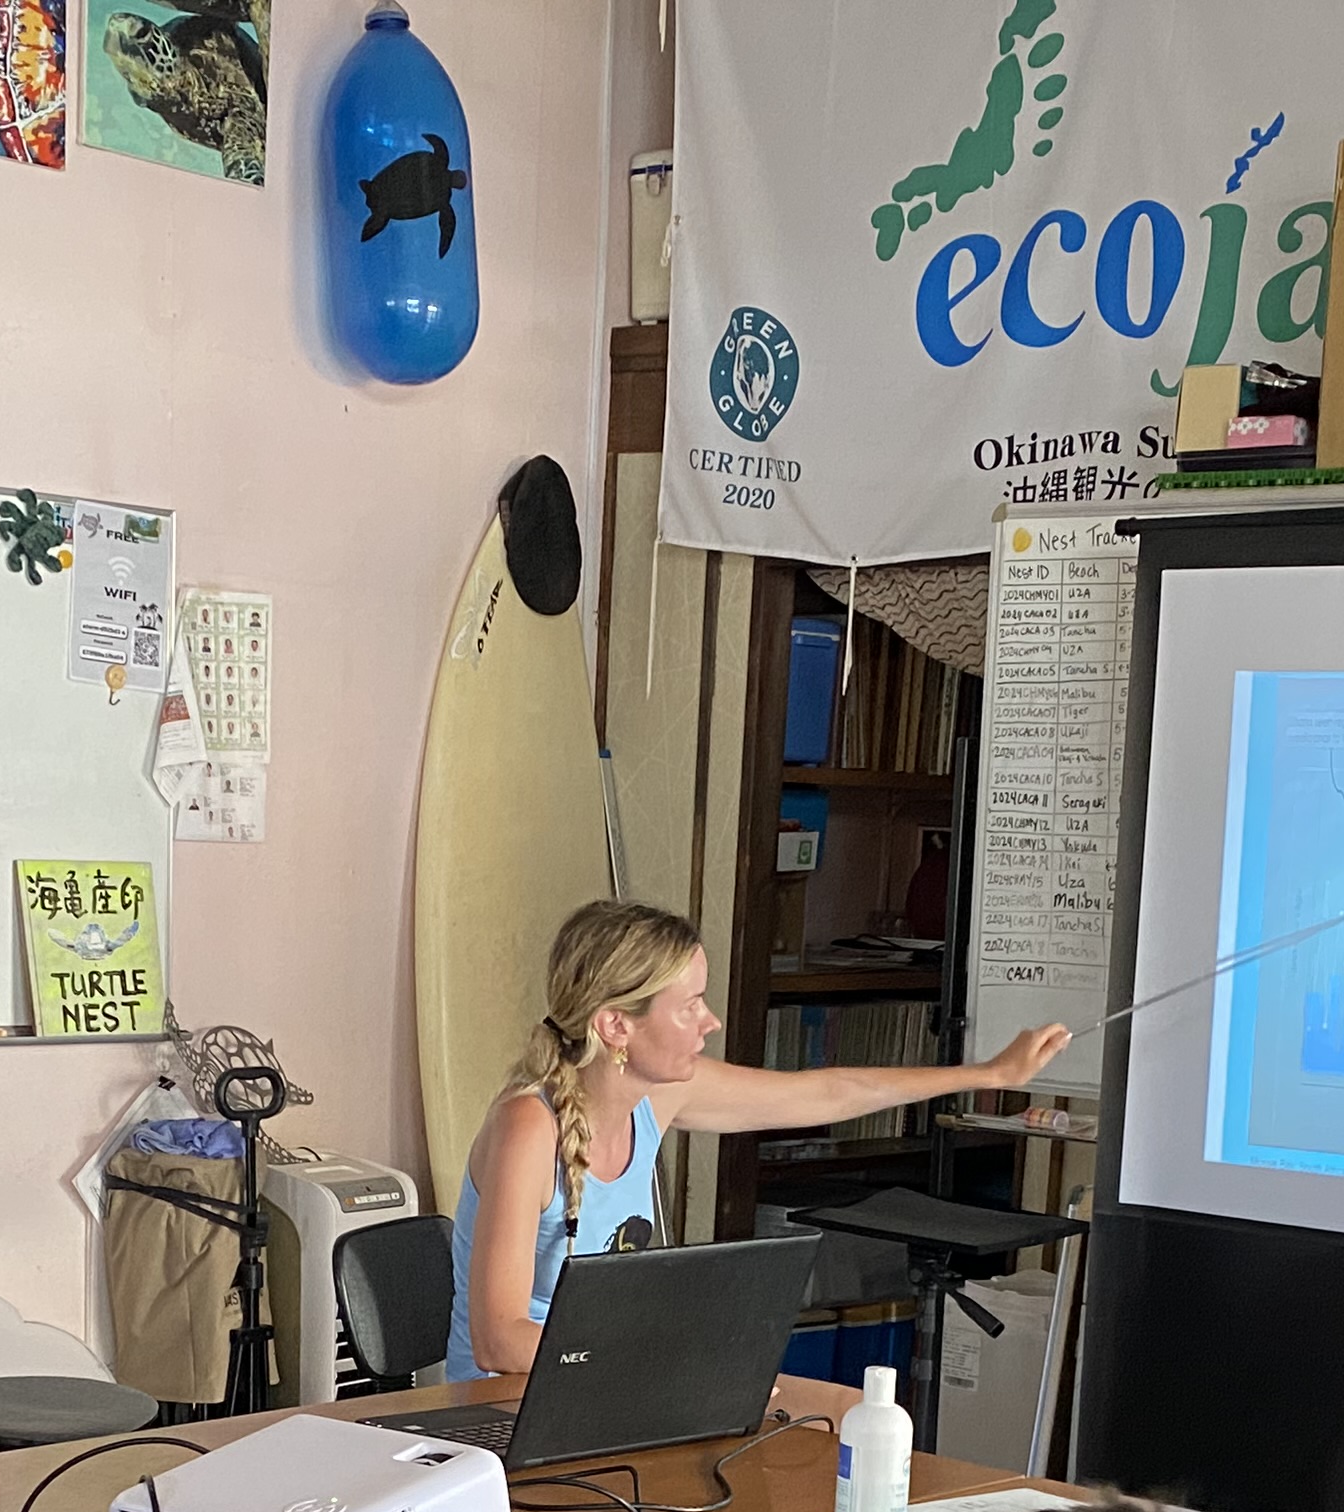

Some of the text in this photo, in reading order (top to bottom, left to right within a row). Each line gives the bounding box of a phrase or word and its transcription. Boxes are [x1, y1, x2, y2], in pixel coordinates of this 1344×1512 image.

[724, 312, 793, 360] GREEN
[718, 394, 785, 437] GLOBE
[973, 428, 1122, 471] Okinawa
[722, 483, 775, 510] 2020
[1039, 528, 1076, 552] Nest
[1009, 565, 1033, 580] Nest
[1037, 565, 1049, 580] ID
[1069, 562, 1099, 579] Beach
[105, 586, 136, 601] WIFI
[1063, 706, 1089, 718] Tiger
[1054, 891, 1100, 910] Malibu
[51, 969, 147, 999] TURTLE
[62, 1001, 141, 1032] NEST
[560, 1350, 592, 1365] NEC
